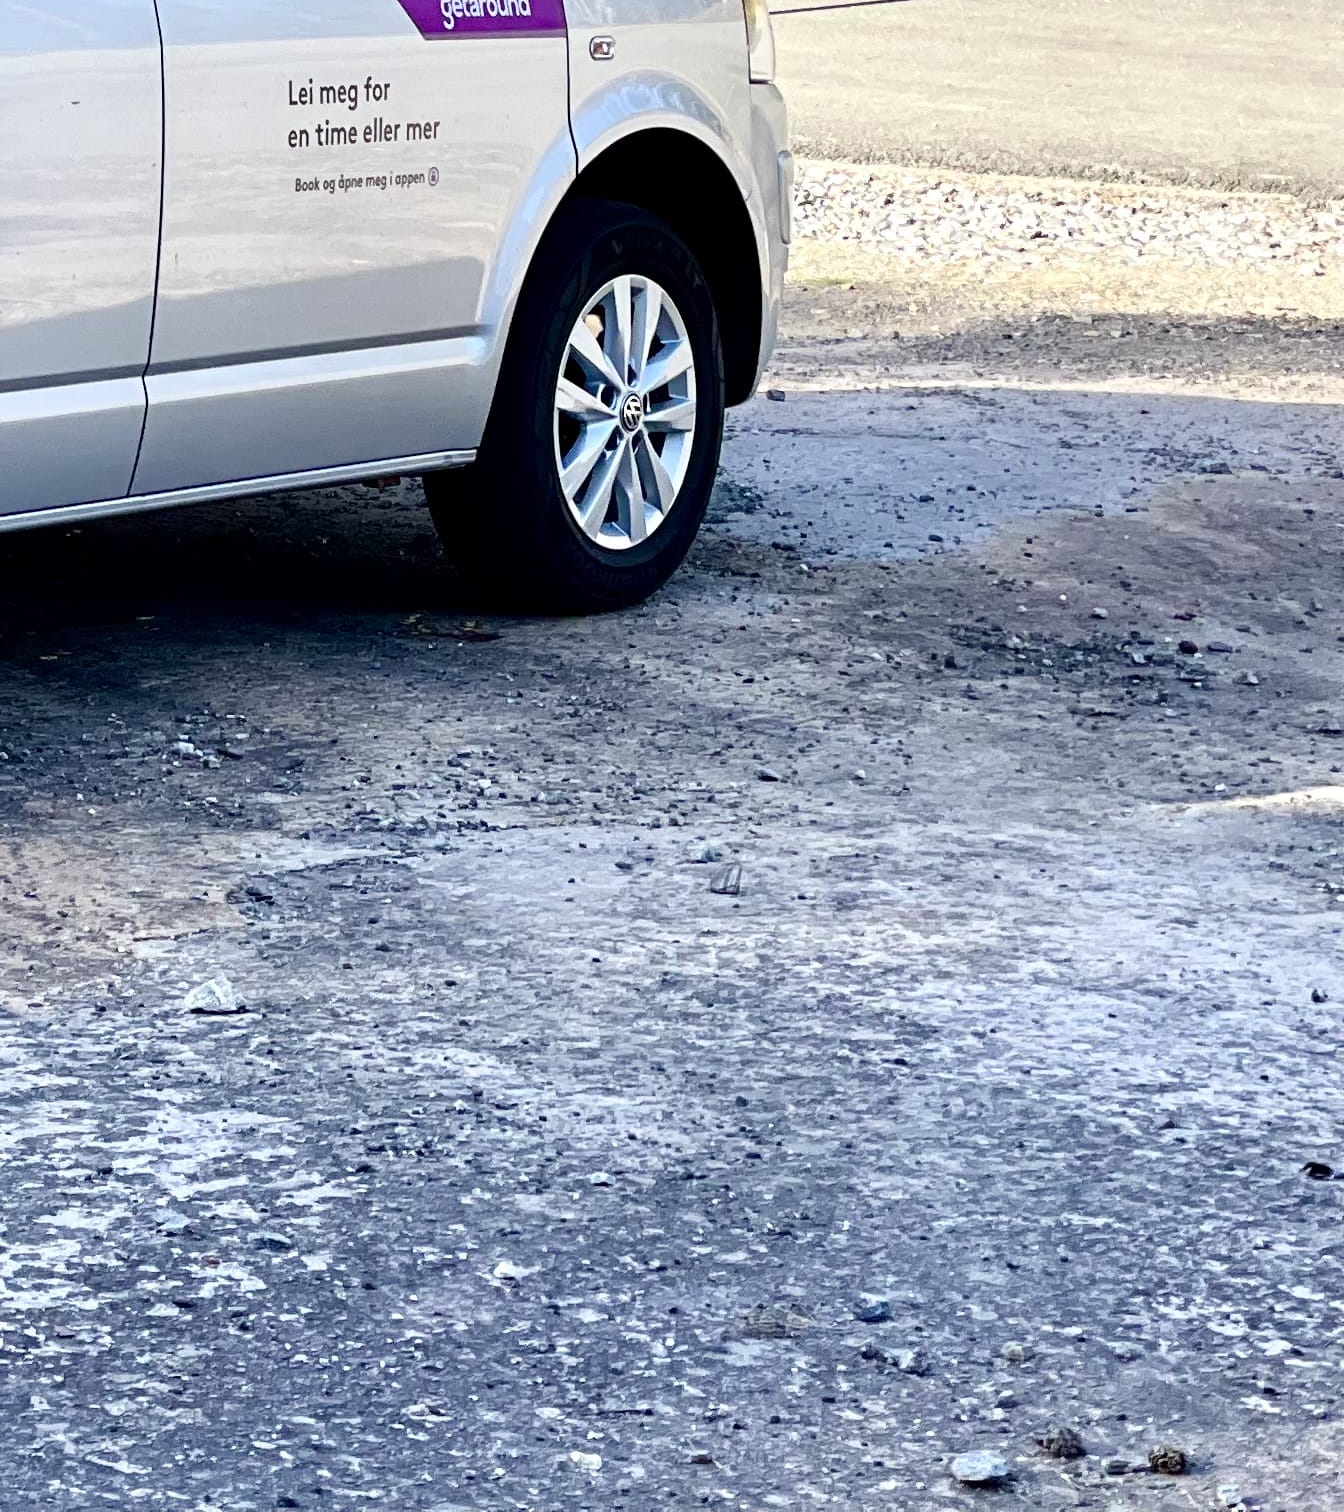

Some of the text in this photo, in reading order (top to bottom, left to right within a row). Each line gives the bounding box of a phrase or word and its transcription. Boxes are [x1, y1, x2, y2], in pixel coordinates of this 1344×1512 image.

[288, 76, 391, 111] Lei meg for
[288, 117, 441, 148] en time eller mer
[295, 178, 320, 192] Book
[323, 179, 335, 194] og
[338, 174, 363, 193] åpne
[365, 176, 387, 190] meg
[395, 173, 425, 189] appen
